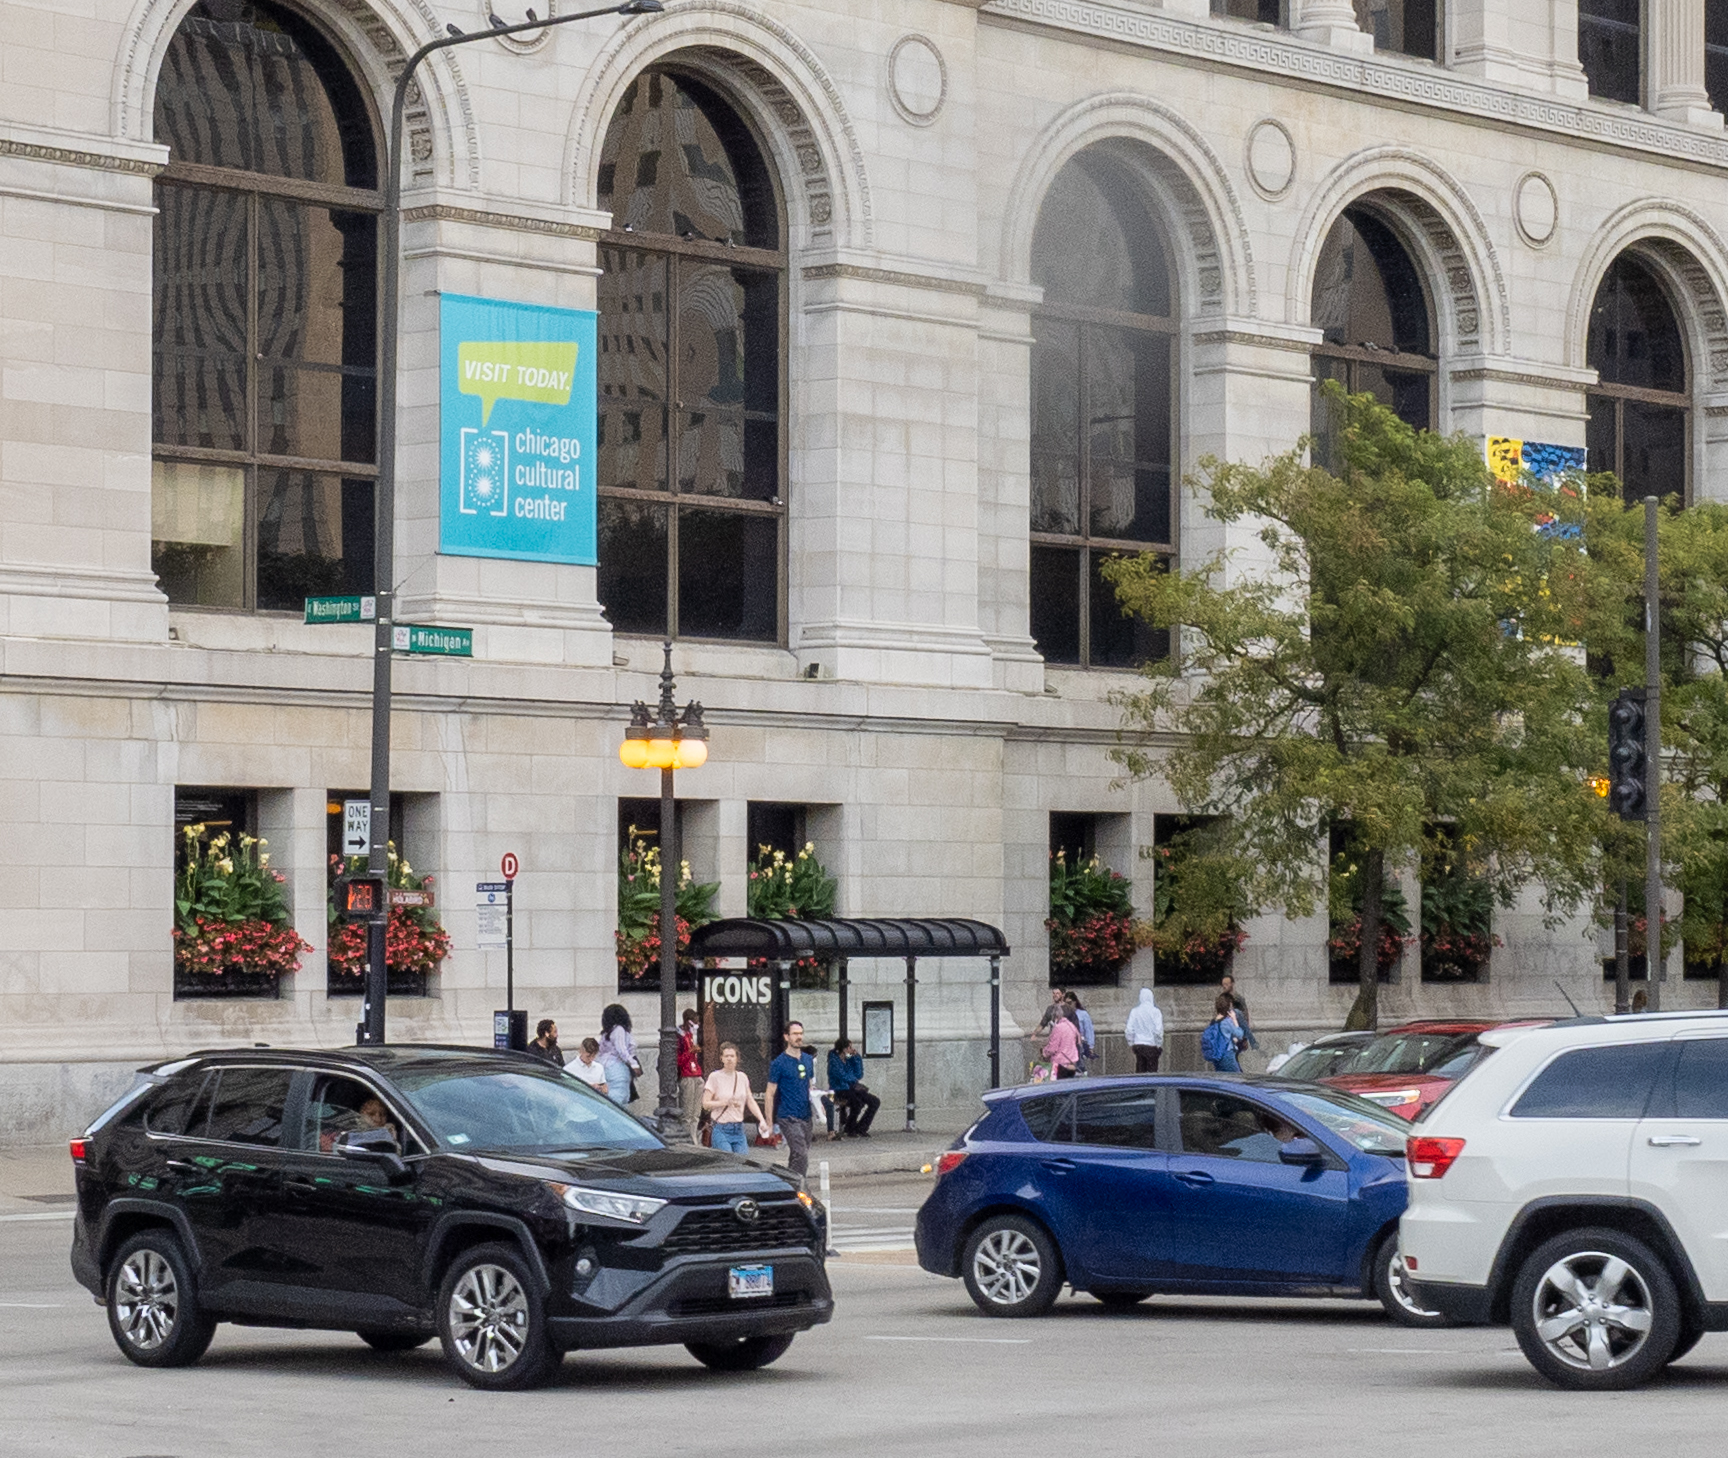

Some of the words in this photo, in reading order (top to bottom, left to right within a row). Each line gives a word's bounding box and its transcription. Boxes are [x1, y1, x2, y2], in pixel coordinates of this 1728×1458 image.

[464, 359, 511, 383] VISIT
[516, 365, 570, 391] TODAY.
[515, 427, 580, 464] chicago
[515, 461, 580, 491] cultural
[514, 494, 567, 521] center
[312, 600, 352, 620] Washington
[417, 631, 462, 653] Michigan
[348, 805, 368, 818] ONE
[347, 820, 369, 832] WAY
[505, 857, 515, 873] D
[704, 976, 772, 1004] ICONS
